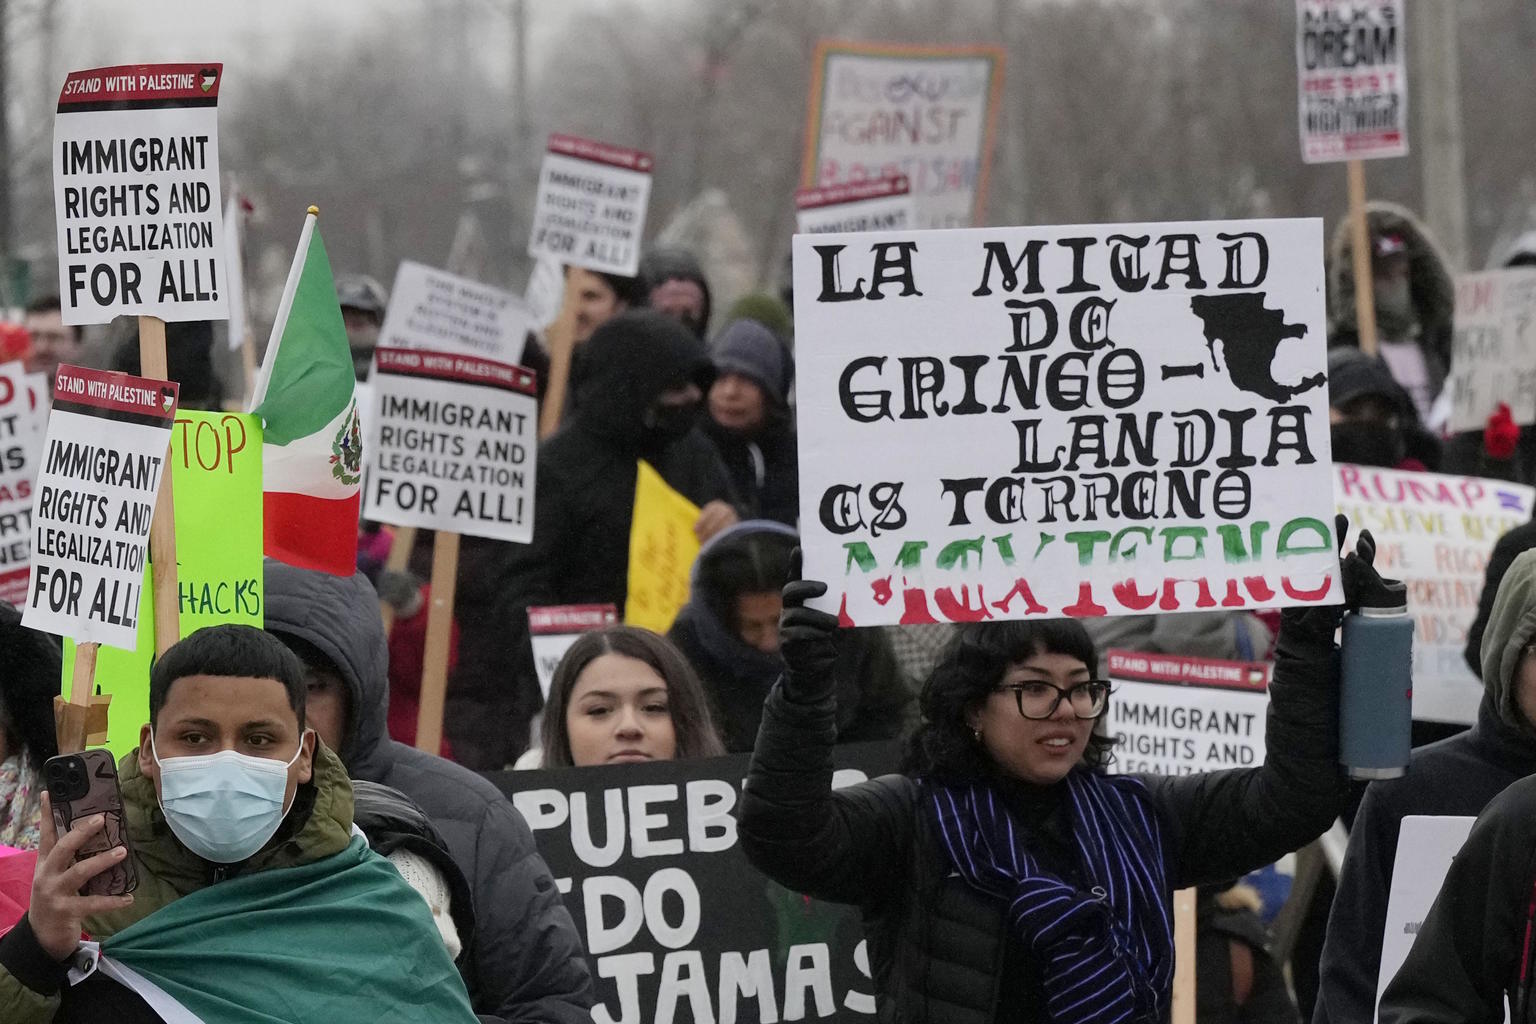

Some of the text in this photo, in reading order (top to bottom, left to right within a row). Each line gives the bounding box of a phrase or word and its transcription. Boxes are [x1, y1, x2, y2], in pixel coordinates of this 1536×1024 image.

[65, 73, 195, 95] STAND WITH PALESTINE
[62, 135, 208, 175] IMMIGRANT
[64, 182, 210, 218] RIGHTS AND
[66, 221, 213, 254] LEGALIZATION
[536, 228, 575, 252] FOR
[68, 258, 219, 308] FOR ALL!
[812, 232, 1270, 302] LA MITAD
[1004, 296, 1118, 352] DE
[381, 352, 513, 382] STAND WITH PALESTINE
[57, 375, 157, 407] STAND WITH PALESTINE
[381, 395, 527, 436] IMMIGRANT
[173, 415, 247, 474] TOP
[380, 426, 525, 465] RIGHTS AND
[1010, 404, 1317, 475] LANDIA
[45, 439, 161, 493] IMMIGRANT
[379, 453, 524, 489] LEGALIZATION
[1339, 462, 1485, 510] RUMP
[39, 486, 152, 537] RIGHTS AND
[375, 478, 524, 525] FOR ALL!
[819, 468, 1252, 537] ES TERRENO
[37, 526, 146, 574] LEGALIZATION
[837, 516, 1333, 628] MEXICANO
[32, 565, 83, 616] FOR
[88, 577, 141, 630] ALL!
[1111, 656, 1242, 682] STAND WITH PALESTINE
[1115, 701, 1256, 737] IMMIGRANT
[1116, 731, 1254, 765] RIGHTS AND
